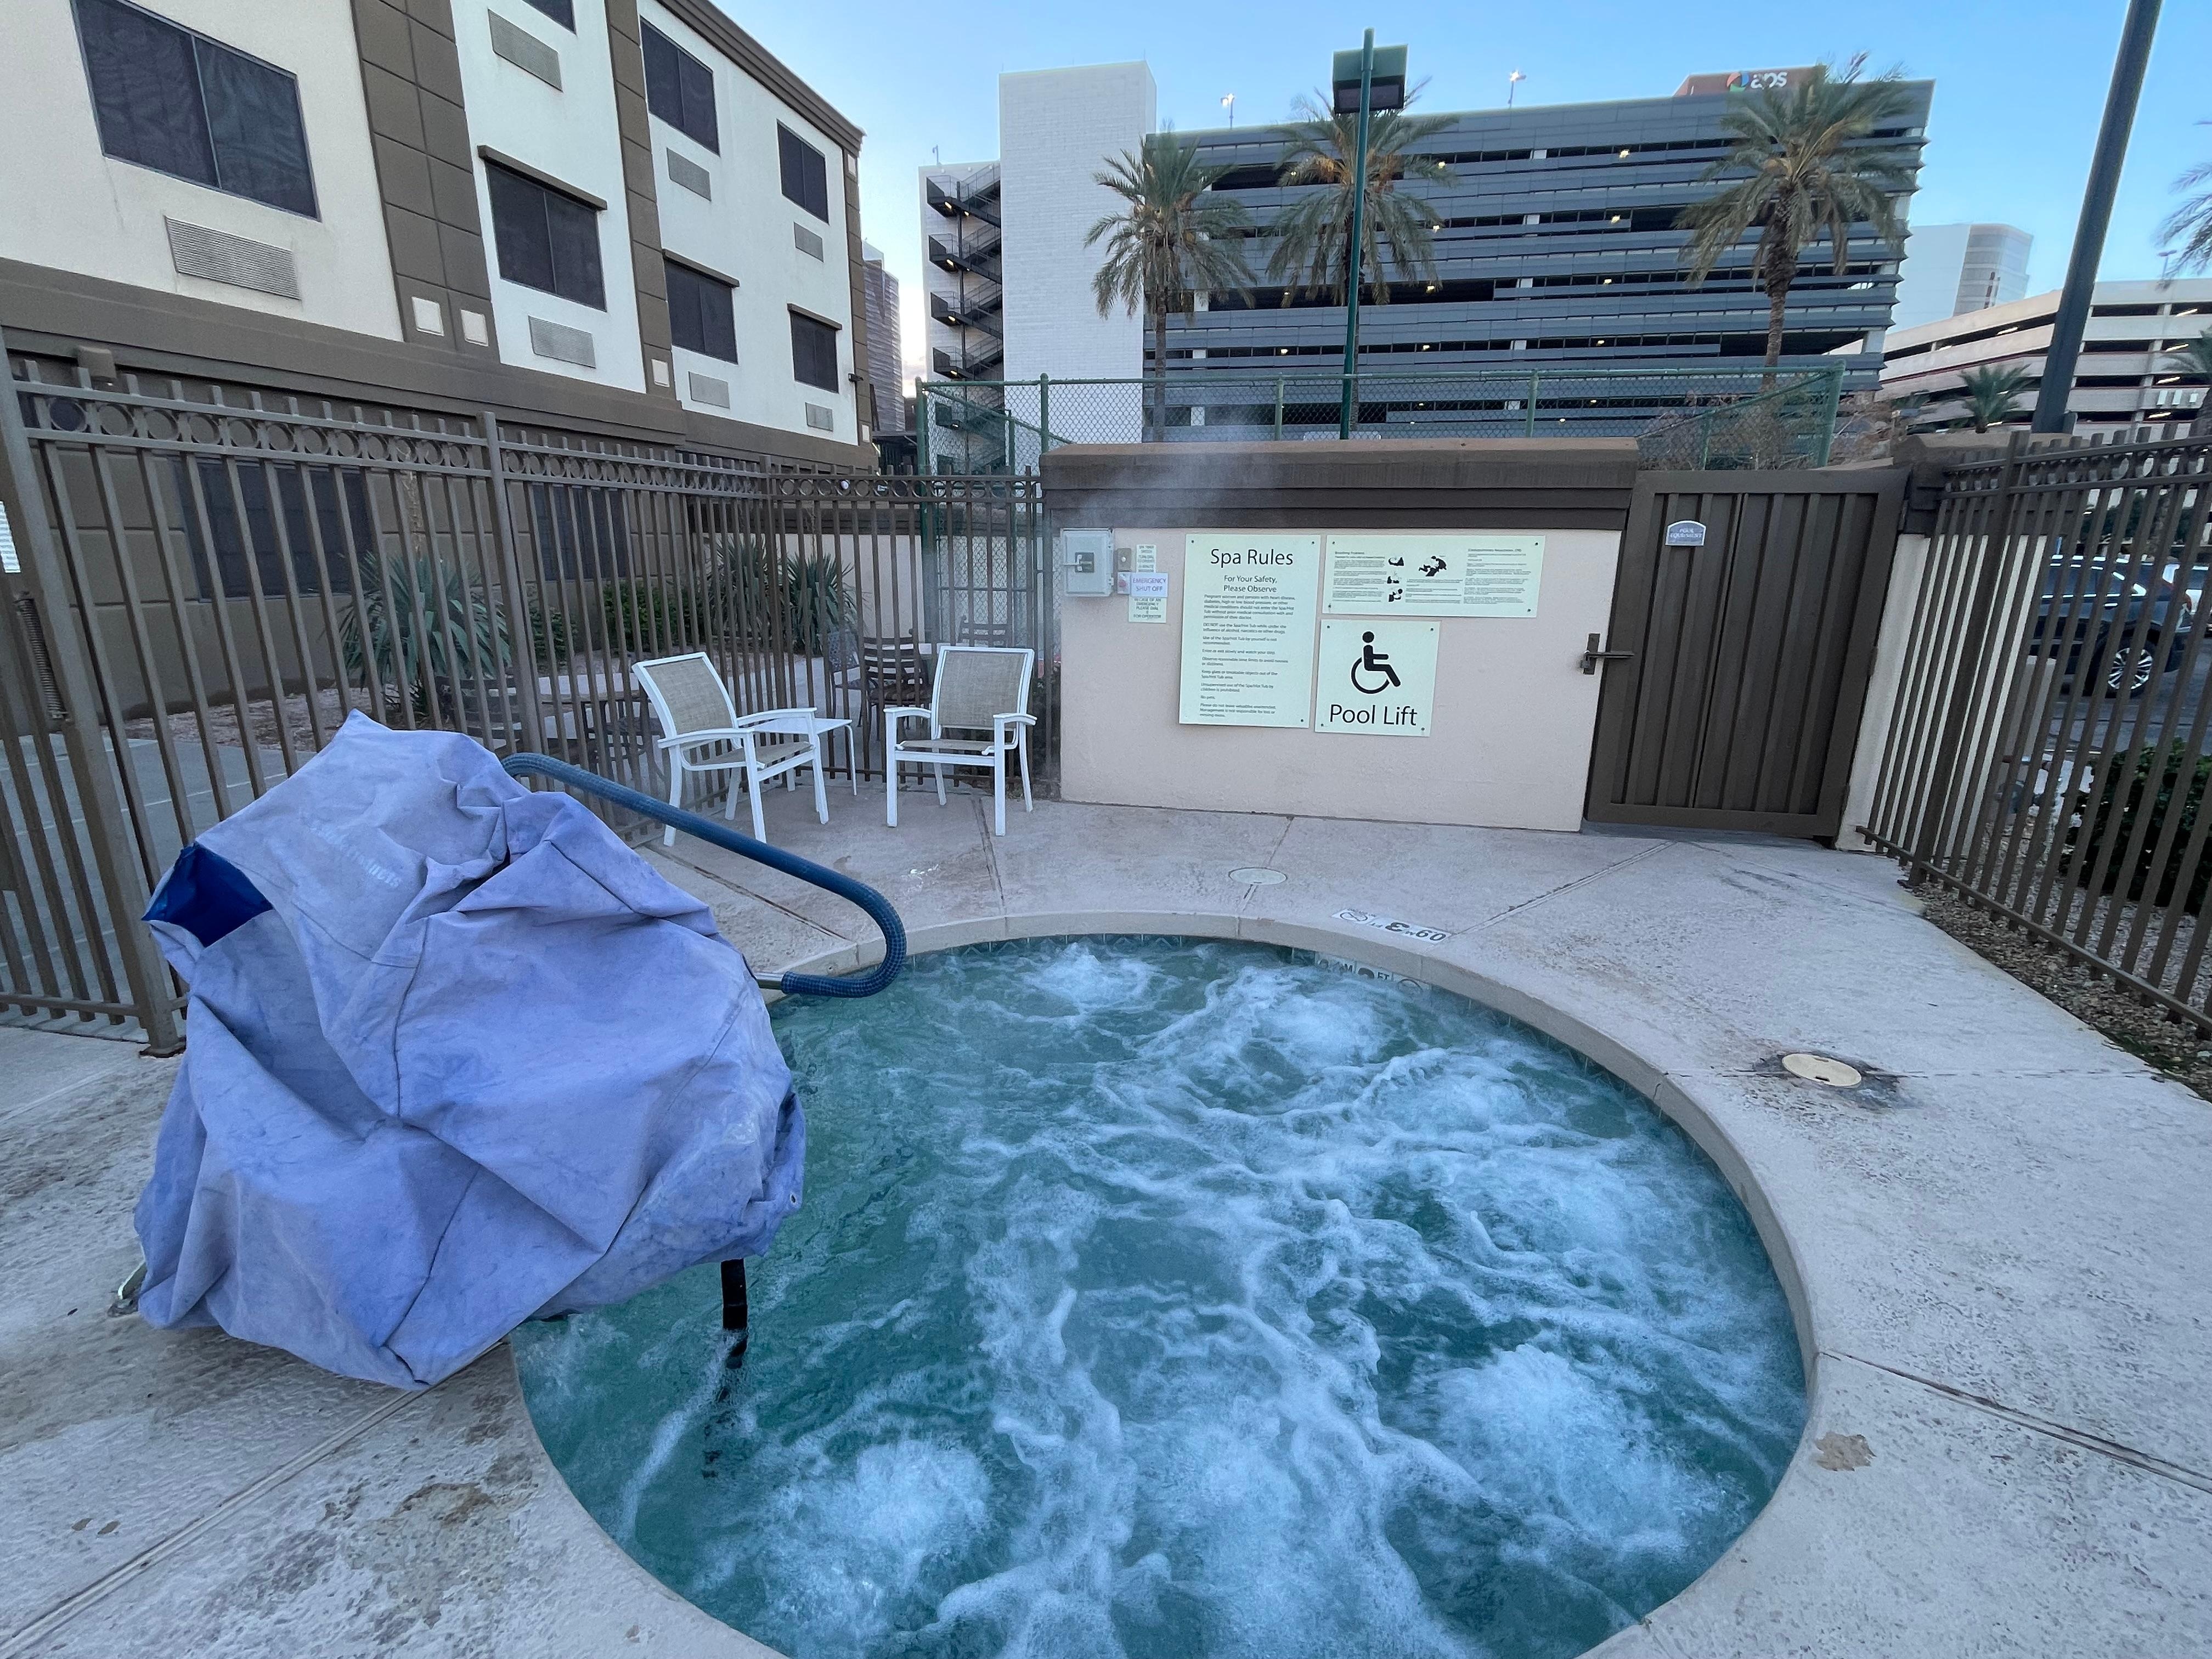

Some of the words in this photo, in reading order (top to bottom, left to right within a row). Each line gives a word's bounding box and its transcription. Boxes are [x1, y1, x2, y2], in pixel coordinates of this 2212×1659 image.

[1210, 549, 1241, 568] Spa
[1248, 549, 1293, 565] Rules
[1254, 575, 1277, 584] Safety,
[1330, 704, 1376, 724] Pool
[1383, 706, 1418, 726] Lift
[1385, 922, 1410, 932] 3
